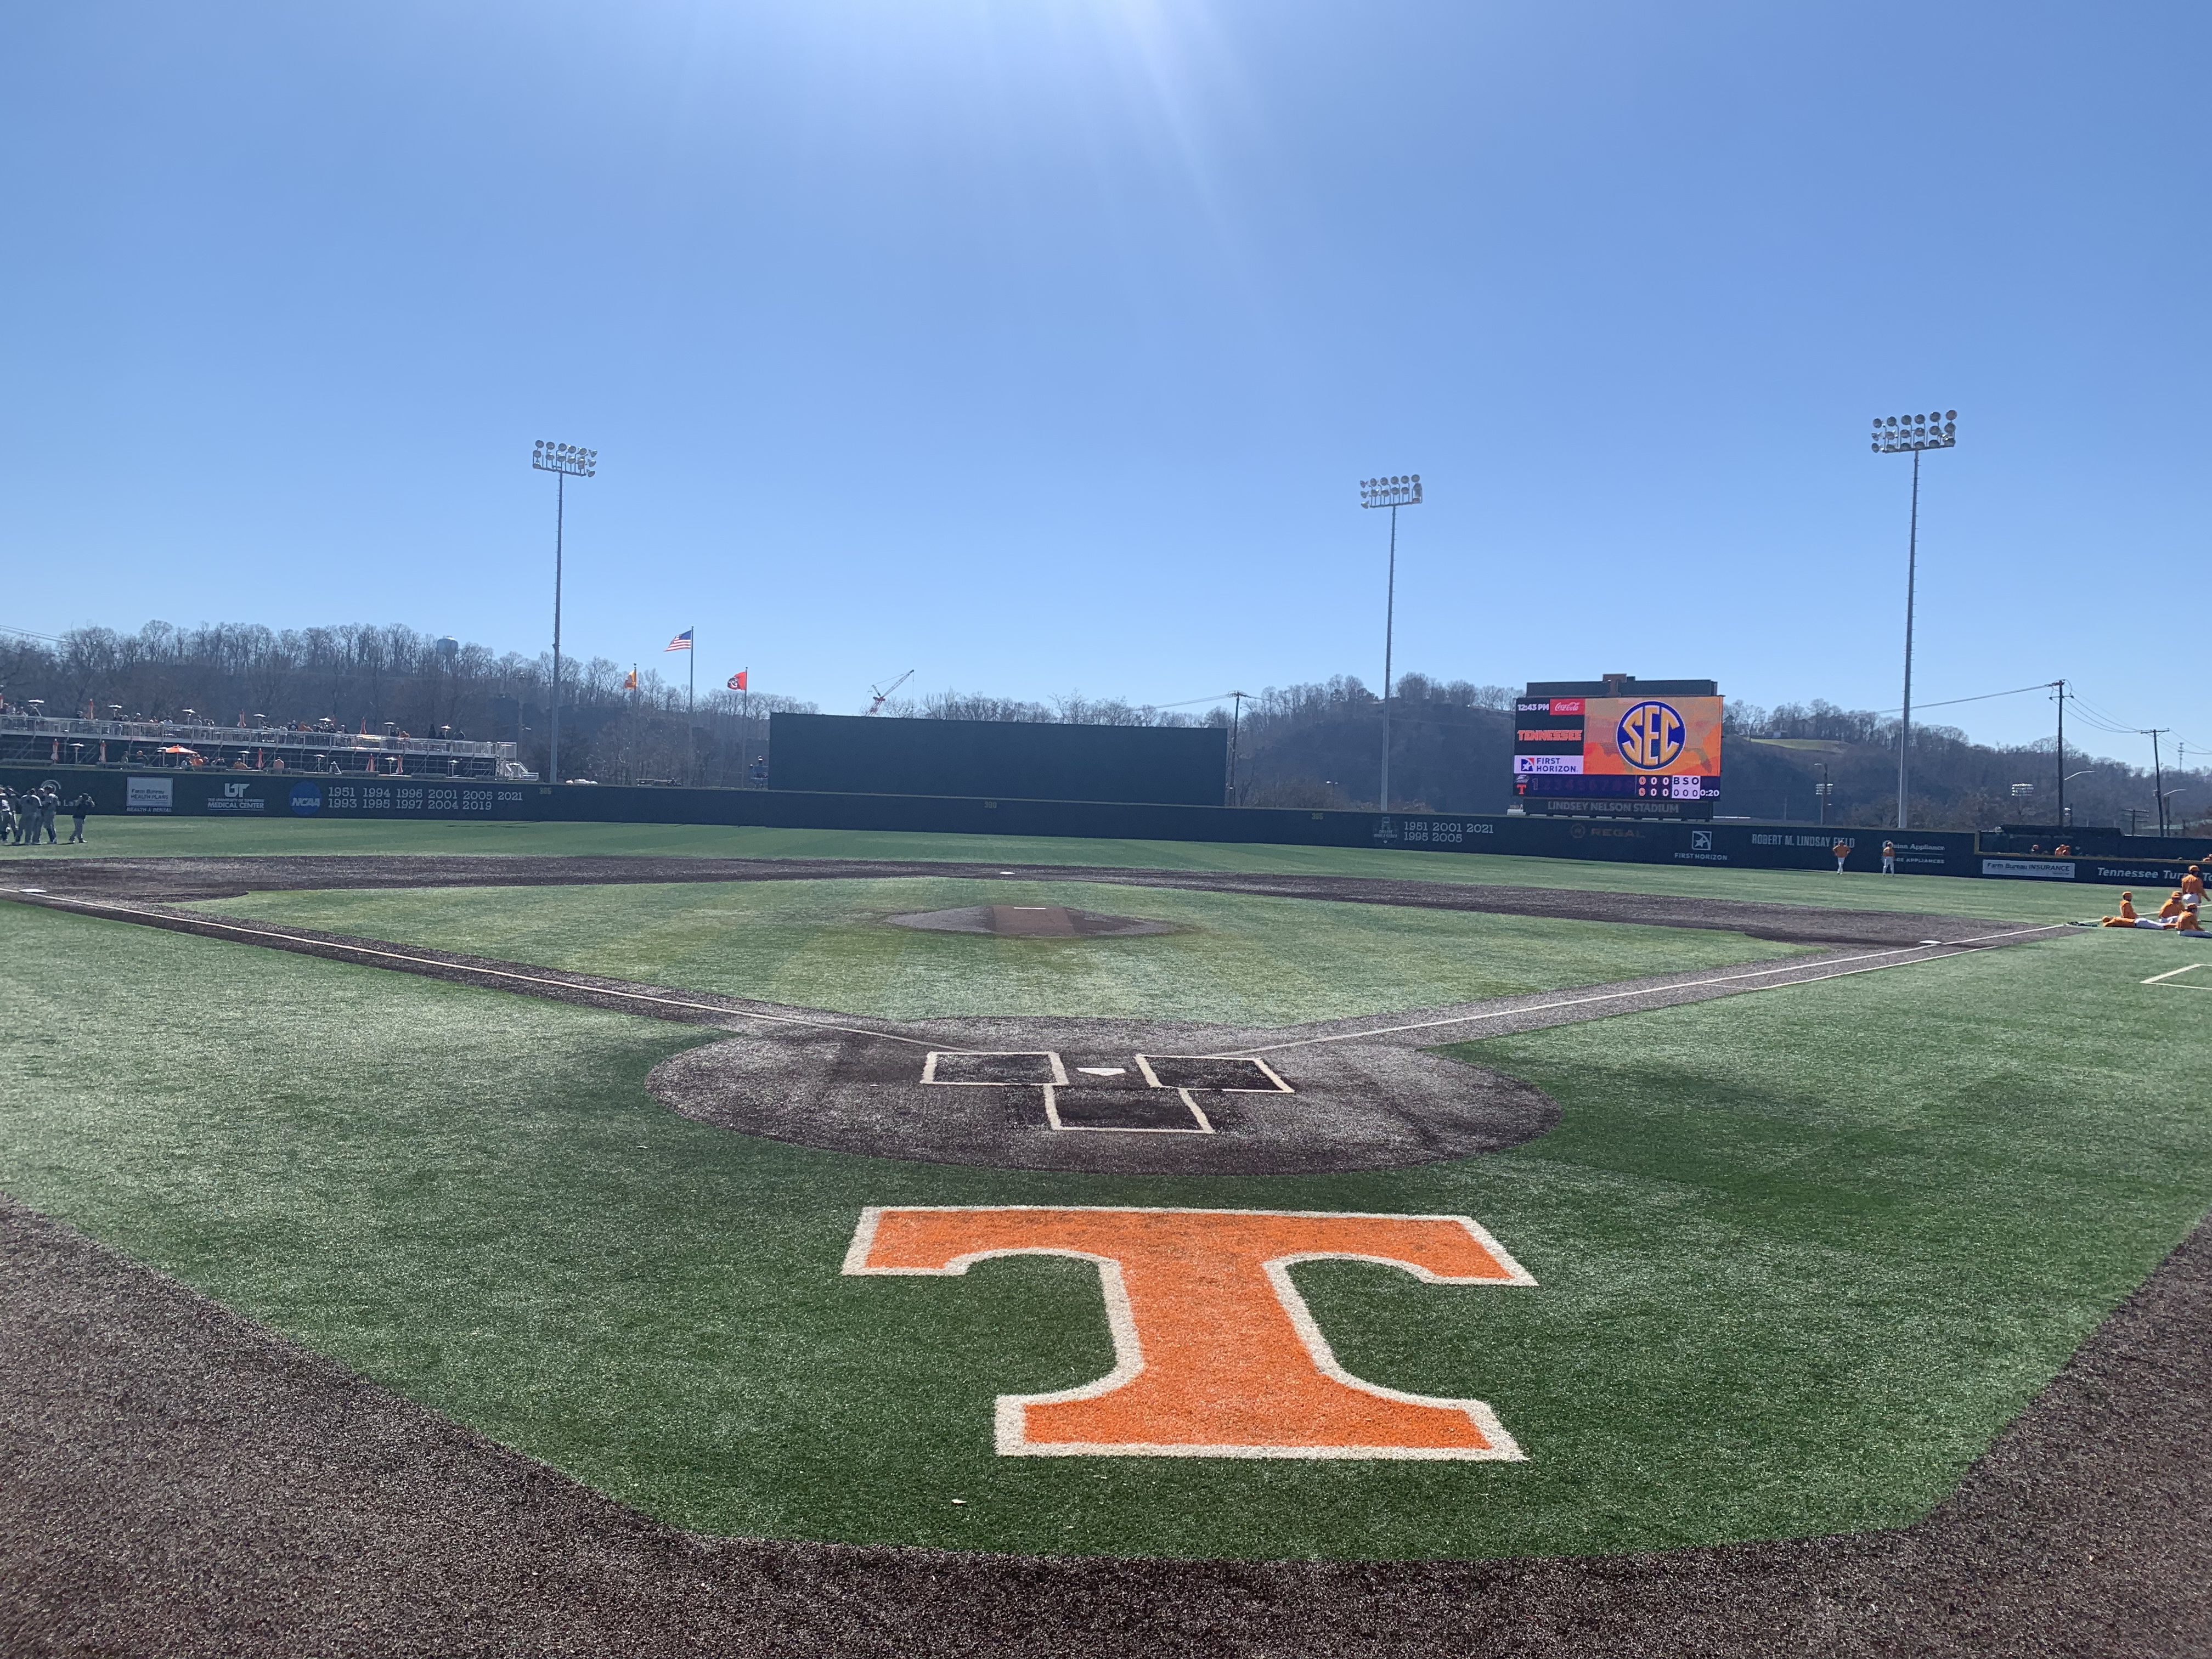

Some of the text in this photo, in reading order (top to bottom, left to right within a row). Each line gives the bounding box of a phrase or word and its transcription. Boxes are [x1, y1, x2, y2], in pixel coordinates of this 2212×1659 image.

[1516, 729, 1583, 741] TENNESSEE
[1622, 705, 1680, 766] SEC
[1651, 776, 1657, 785] 0
[1662, 777, 1669, 785] 0
[1691, 777, 1699, 785] O
[224, 783, 250, 798] UT
[328, 787, 355, 797] 1951
[363, 787, 391, 798] 1994
[428, 789, 458, 799] 2001
[463, 790, 493, 800] 2005
[497, 791, 523, 801] 2021
[1517, 784, 1527, 794] T
[1650, 788, 1657, 796] 0
[1662, 788, 1669, 797] 0
[291, 797, 320, 807] NCAA
[328, 798, 357, 808] 1993
[396, 799, 424, 809] 1997
[428, 800, 458, 809] 2004
[462, 800, 492, 810] 2019
[1548, 801, 1679, 813] LINDSEY NELSON STADIUM
[1404, 821, 1494, 833] 1951 2001 2021
[1591, 828, 1644, 838] REGAL
[1404, 832, 1429, 842] 1995
[1432, 832, 1463, 843] 2005
[1752, 833, 1782, 845] ROBERT
[1797, 836, 1831, 847] LINDSAY
[2097, 867, 2159, 878] Tennessee
[841, 1205, 1539, 1462] T
